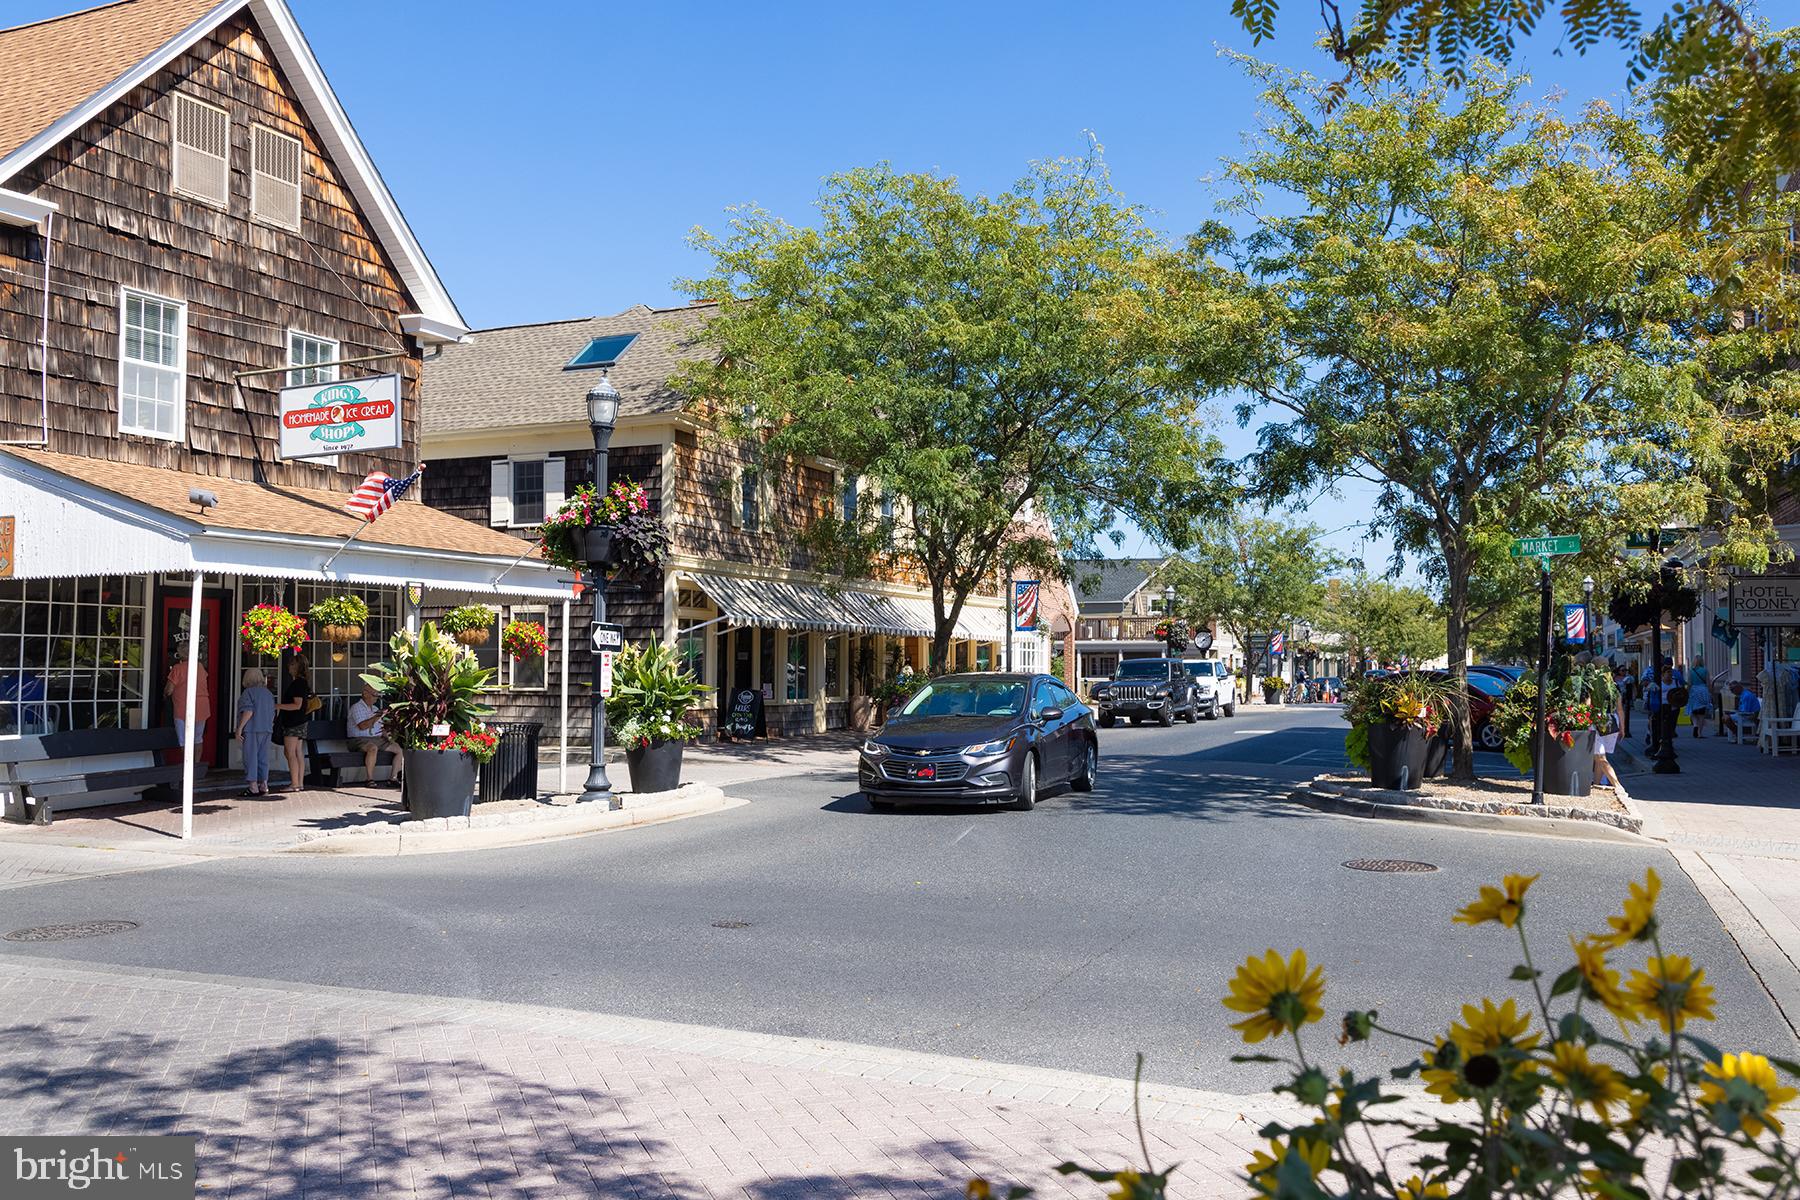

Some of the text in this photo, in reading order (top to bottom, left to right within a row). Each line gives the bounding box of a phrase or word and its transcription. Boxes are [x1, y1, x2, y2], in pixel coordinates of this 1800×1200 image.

[321, 387, 354, 404] KING'S
[288, 404, 389, 425] HOMEMADE ICE CREAM
[320, 423, 355, 438] SHOPS
[1521, 540, 1558, 553] MARKET
[1742, 586, 1793, 597] HOTEL
[1735, 598, 1800, 609] RODNEY
[600, 632, 620, 644] ONE WAY
